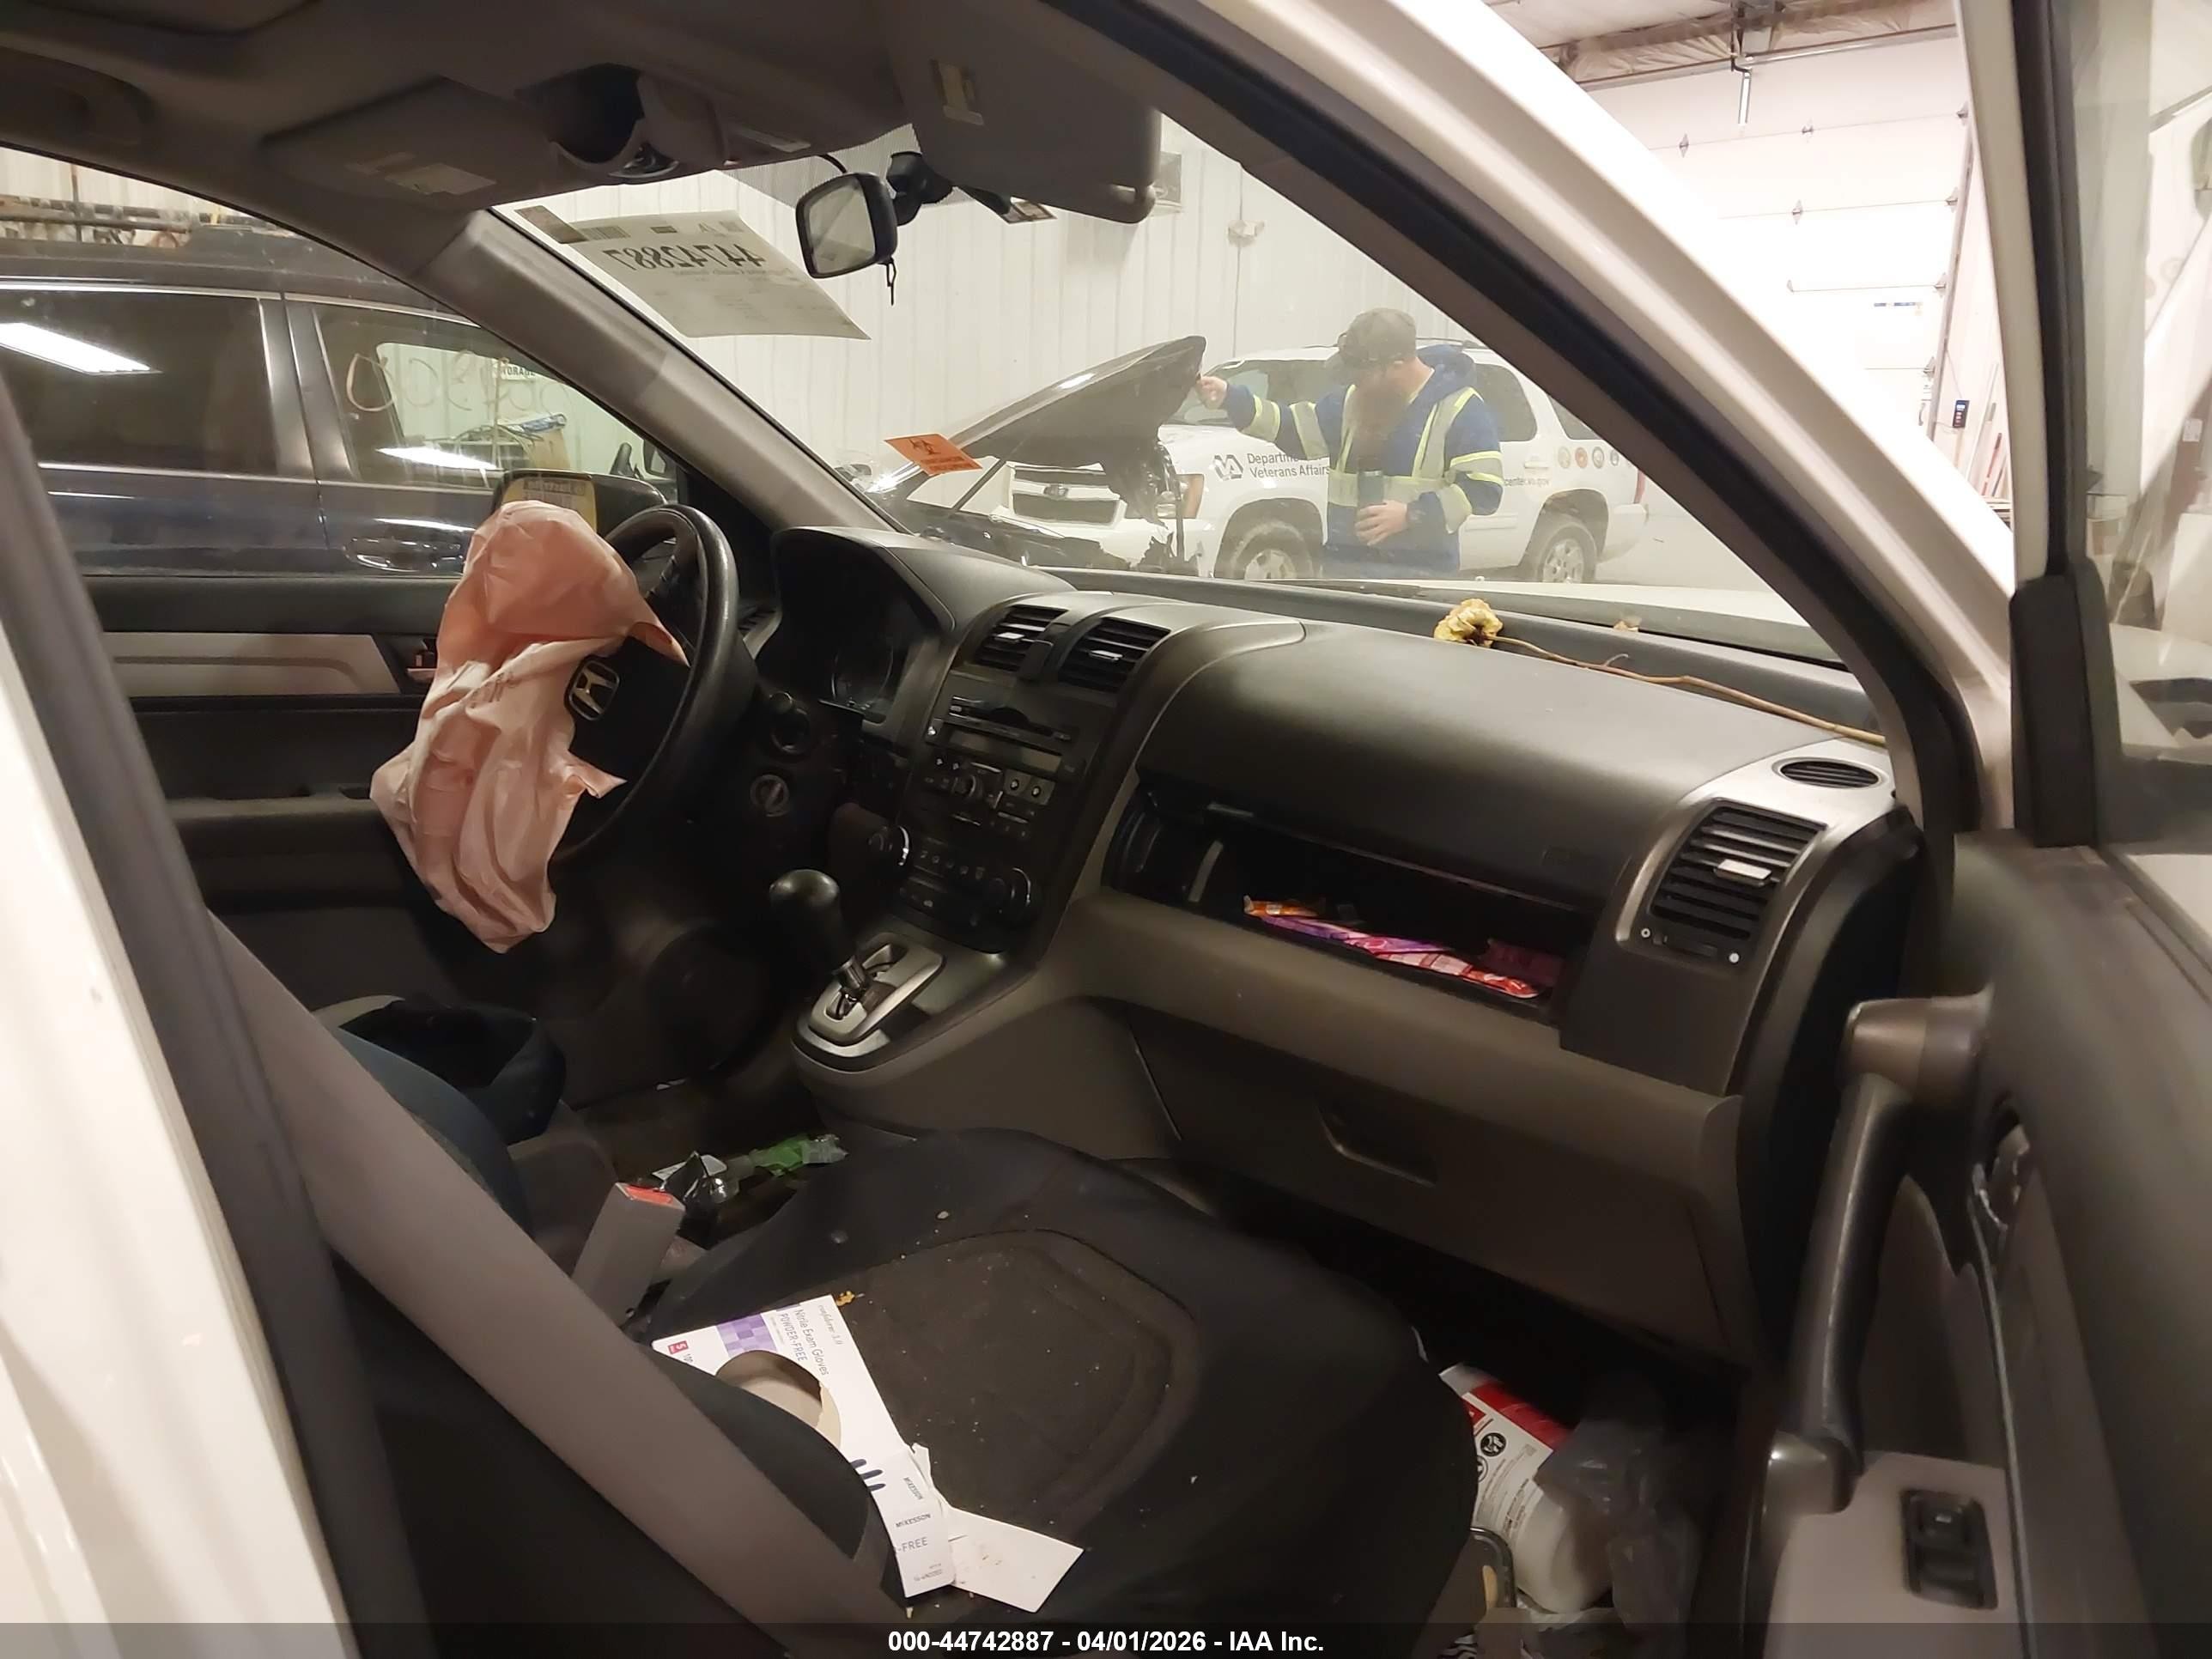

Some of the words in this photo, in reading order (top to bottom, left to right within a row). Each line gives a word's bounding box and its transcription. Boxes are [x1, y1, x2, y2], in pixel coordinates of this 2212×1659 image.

[1249, 466, 1297, 478] Veterans
[1299, 464, 1330, 476] Affairs
[780, 1313, 808, 1361] POWDER-FREE
[803, 1329, 817, 1349] Exam
[813, 1348, 830, 1376] Gloves
